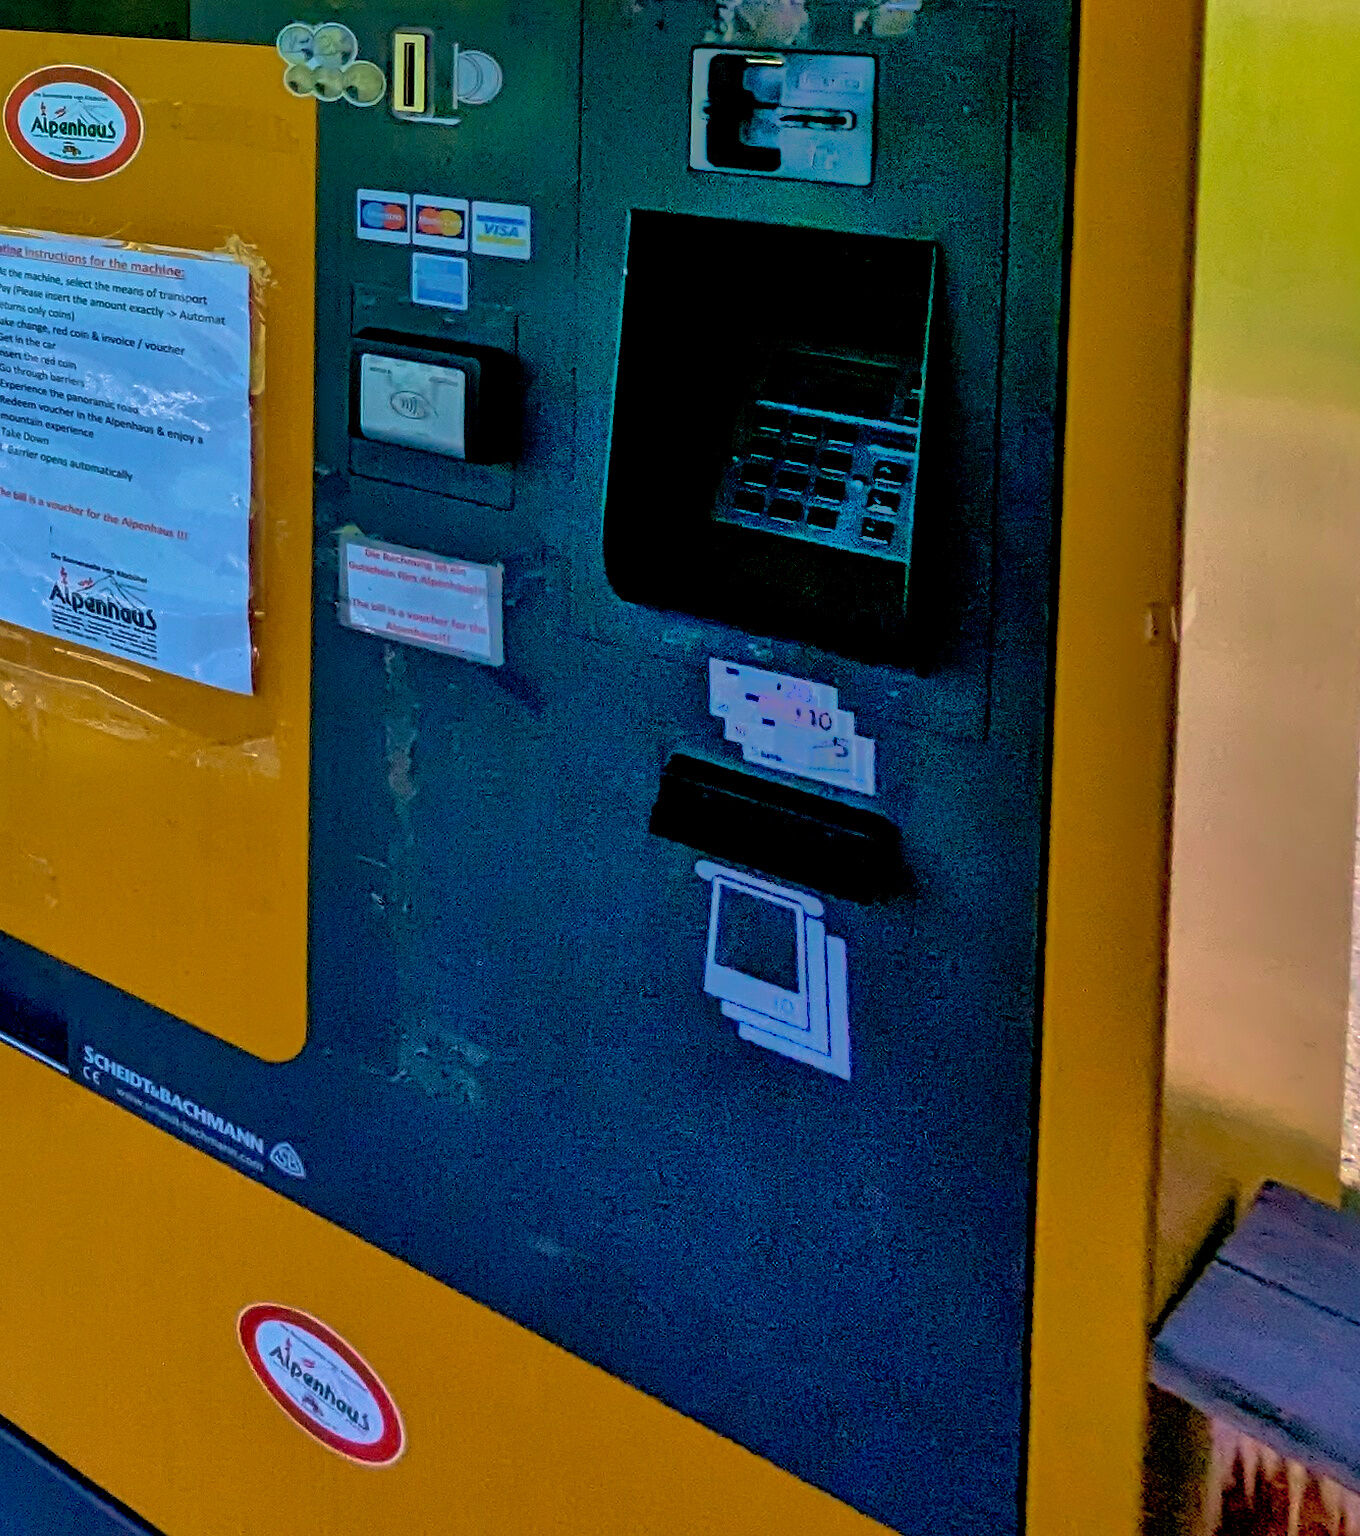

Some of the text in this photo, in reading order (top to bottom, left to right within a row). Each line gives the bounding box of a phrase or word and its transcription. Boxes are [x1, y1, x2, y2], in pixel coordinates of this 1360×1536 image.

[484, 223, 519, 238] VISA
[24, 246, 86, 264] instructions
[90, 254, 104, 267] for
[109, 257, 126, 270] the
[8, 268, 21, 278] the
[65, 276, 91, 288] select
[112, 284, 143, 296] means
[146, 286, 156, 297] of
[158, 289, 207, 306] transport
[45, 291, 69, 302] insert
[72, 295, 87, 305] the
[89, 297, 126, 311] amount
[179, 310, 226, 325] Automat
[25, 336, 40, 347] the
[52, 325, 67, 336] red
[91, 331, 98, 341] &
[101, 333, 135, 347] invoice
[144, 340, 184, 355] voucher
[0, 378, 47, 397] Experience
[49, 387, 63, 399] the
[0, 410, 94, 439] mountain experience
[38, 402, 74, 418] voucher
[87, 411, 102, 424] the
[104, 414, 153, 435] Alpenhaus
[156, 425, 164, 437] &
[167, 428, 194, 445] enjoy
[69, 457, 133, 483] automatically
